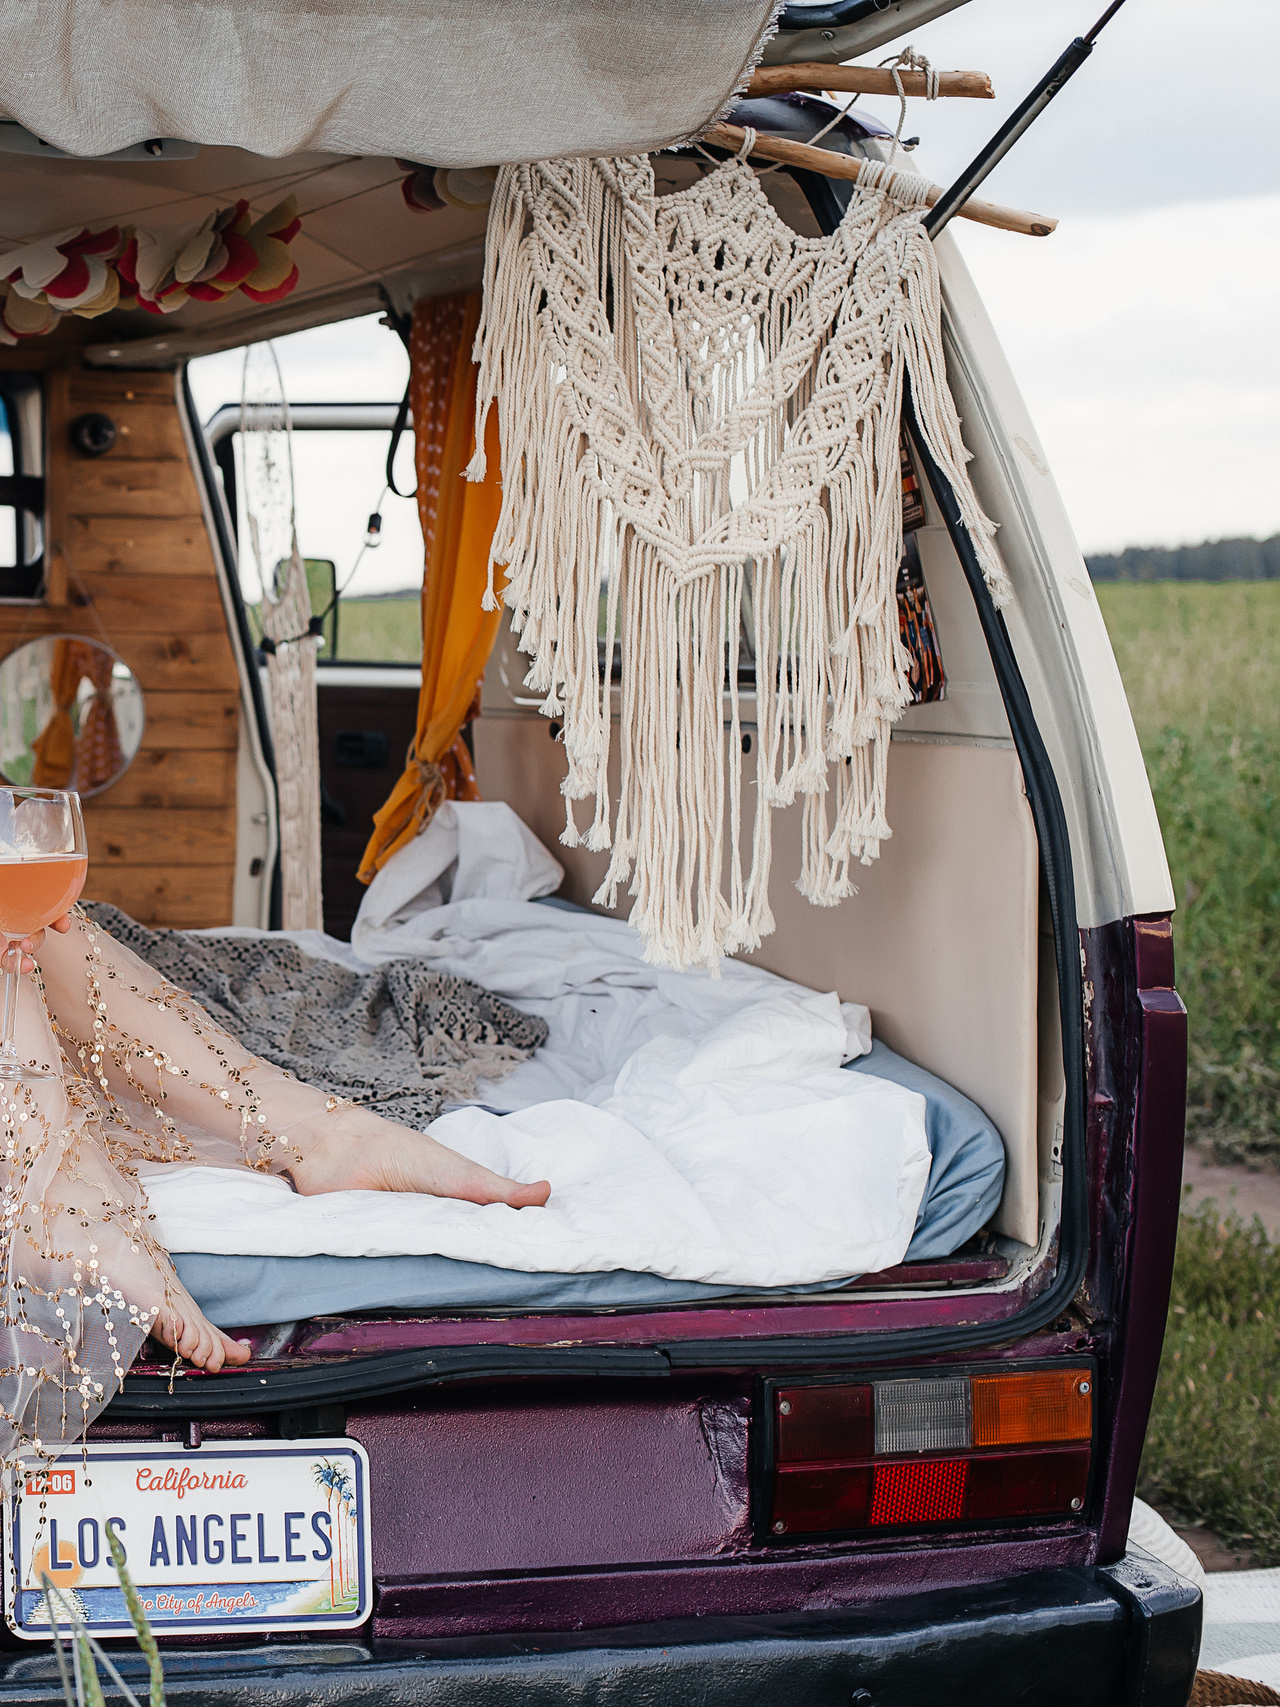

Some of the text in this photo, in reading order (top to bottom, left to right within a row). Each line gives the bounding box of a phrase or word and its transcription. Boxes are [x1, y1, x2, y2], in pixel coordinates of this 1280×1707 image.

[135, 1466, 248, 1499] California
[149, 1511, 332, 1567] ANGELES
[156, 1594, 184, 1615] City
[187, 1592, 204, 1614] of
[205, 1591, 258, 1613] Angels
